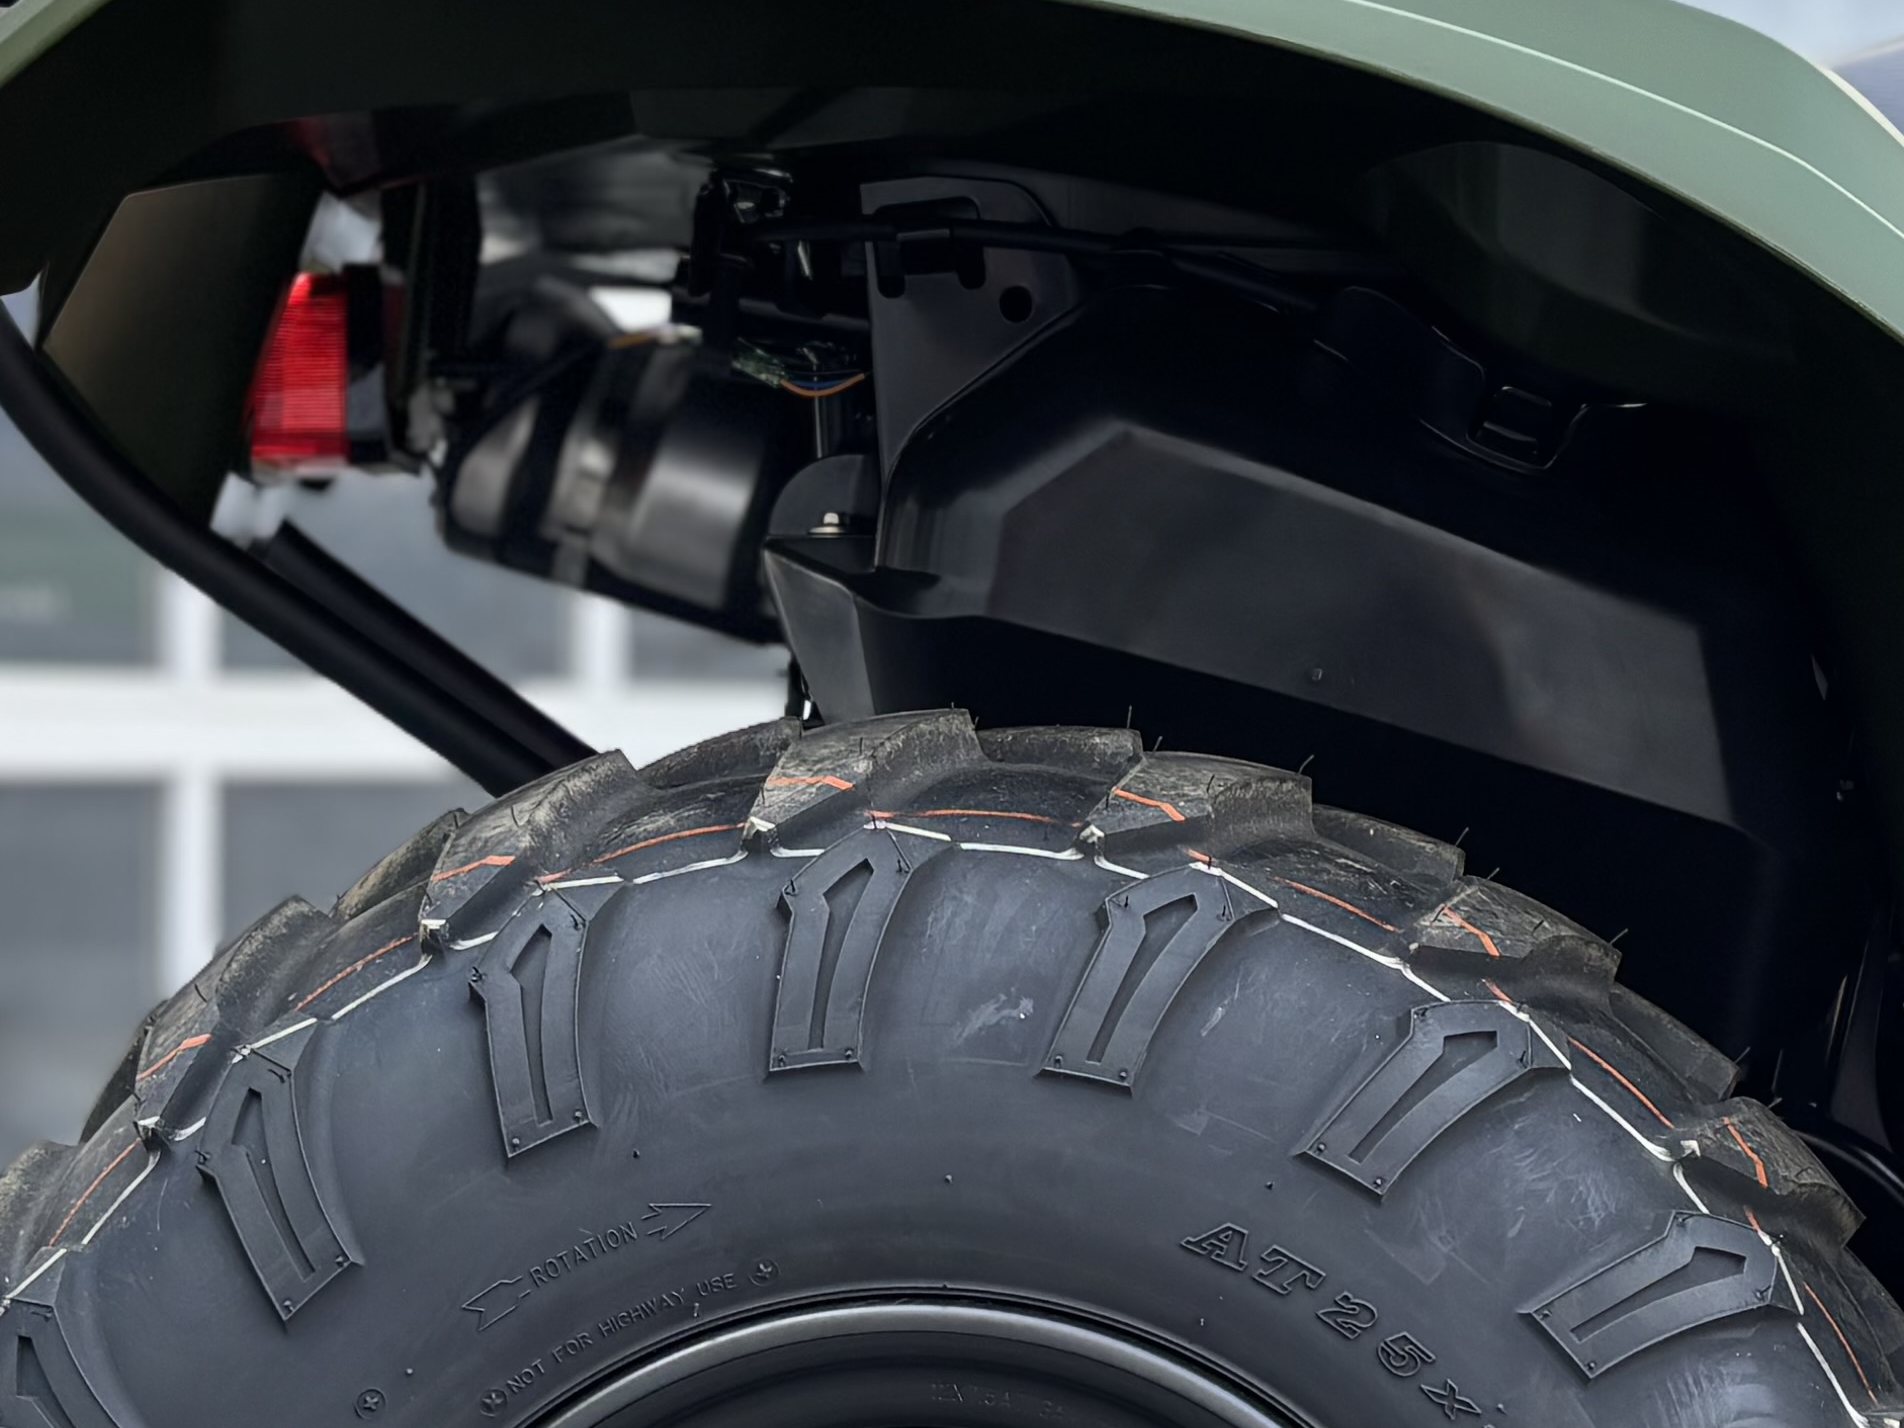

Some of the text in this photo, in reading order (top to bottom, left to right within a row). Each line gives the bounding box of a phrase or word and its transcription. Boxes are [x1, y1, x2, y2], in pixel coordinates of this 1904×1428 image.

[529, 1222, 639, 1288] ROTATION
[506, 1272, 738, 1395] NOT FOR HIGHWAY USE
